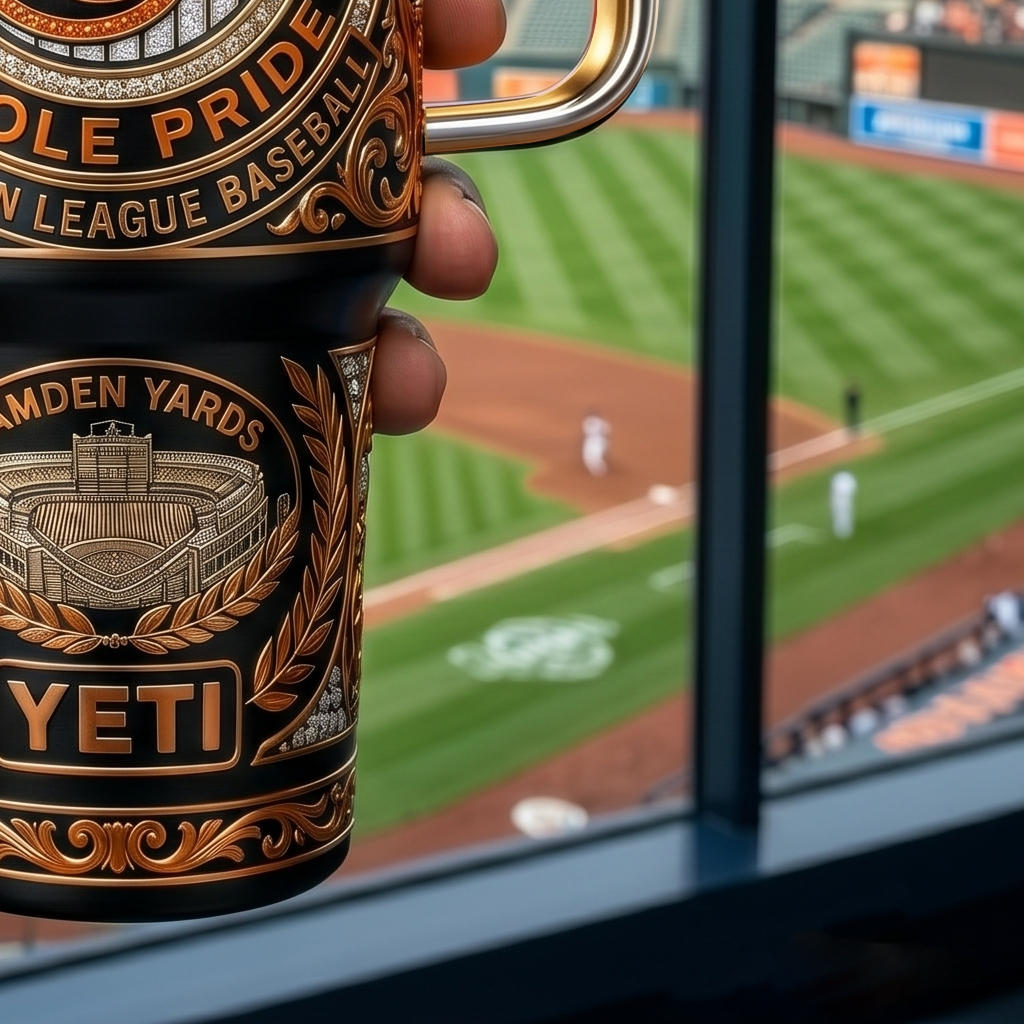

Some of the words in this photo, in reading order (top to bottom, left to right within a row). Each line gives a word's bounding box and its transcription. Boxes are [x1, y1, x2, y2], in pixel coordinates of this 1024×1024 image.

[33, 188, 208, 239] LEAGUE
[217, 56, 370, 213] BASEBALL
[144, 377, 265, 451] YARDS
[7, 680, 220, 754] YETI
